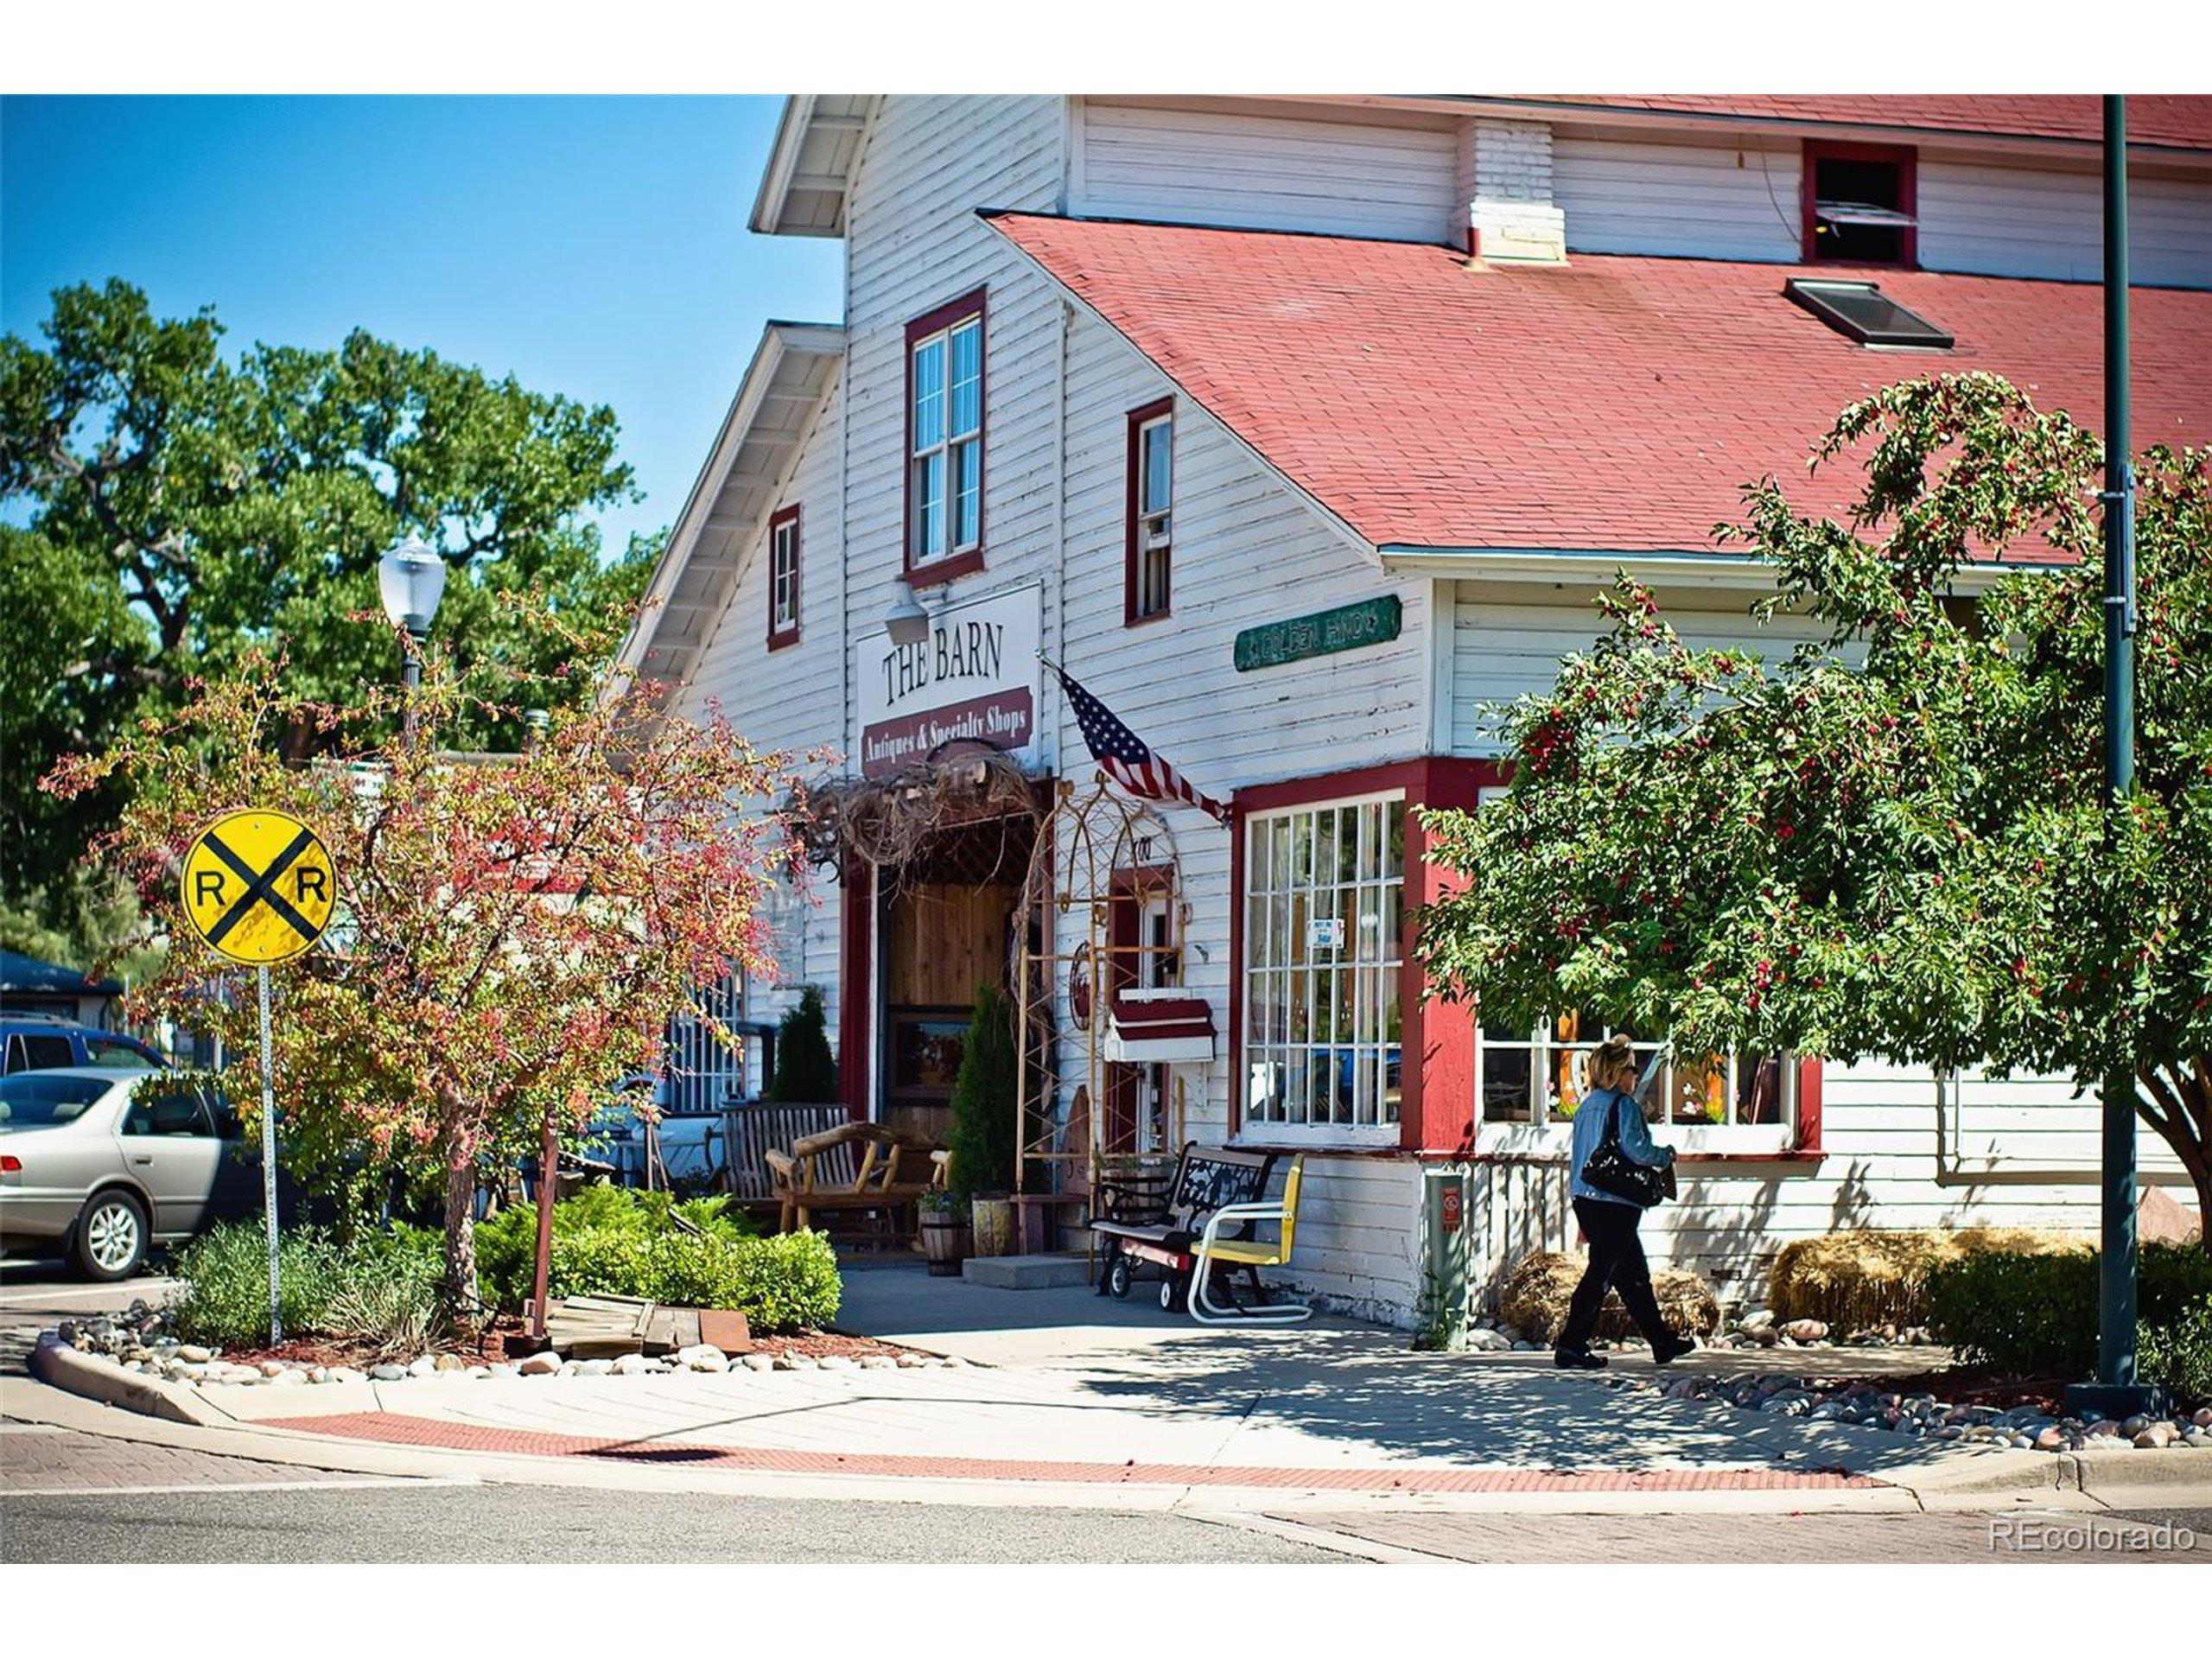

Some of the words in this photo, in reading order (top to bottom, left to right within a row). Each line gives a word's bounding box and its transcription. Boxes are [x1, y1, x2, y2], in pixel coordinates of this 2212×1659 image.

[883, 641, 930, 707] THE
[934, 621, 1003, 682] BARN
[867, 734, 915, 763] Antiques
[917, 724, 927, 750] &
[930, 711, 985, 747] Specialty
[987, 705, 1027, 737] Shops
[196, 871, 226, 906] R
[296, 867, 327, 903] R
